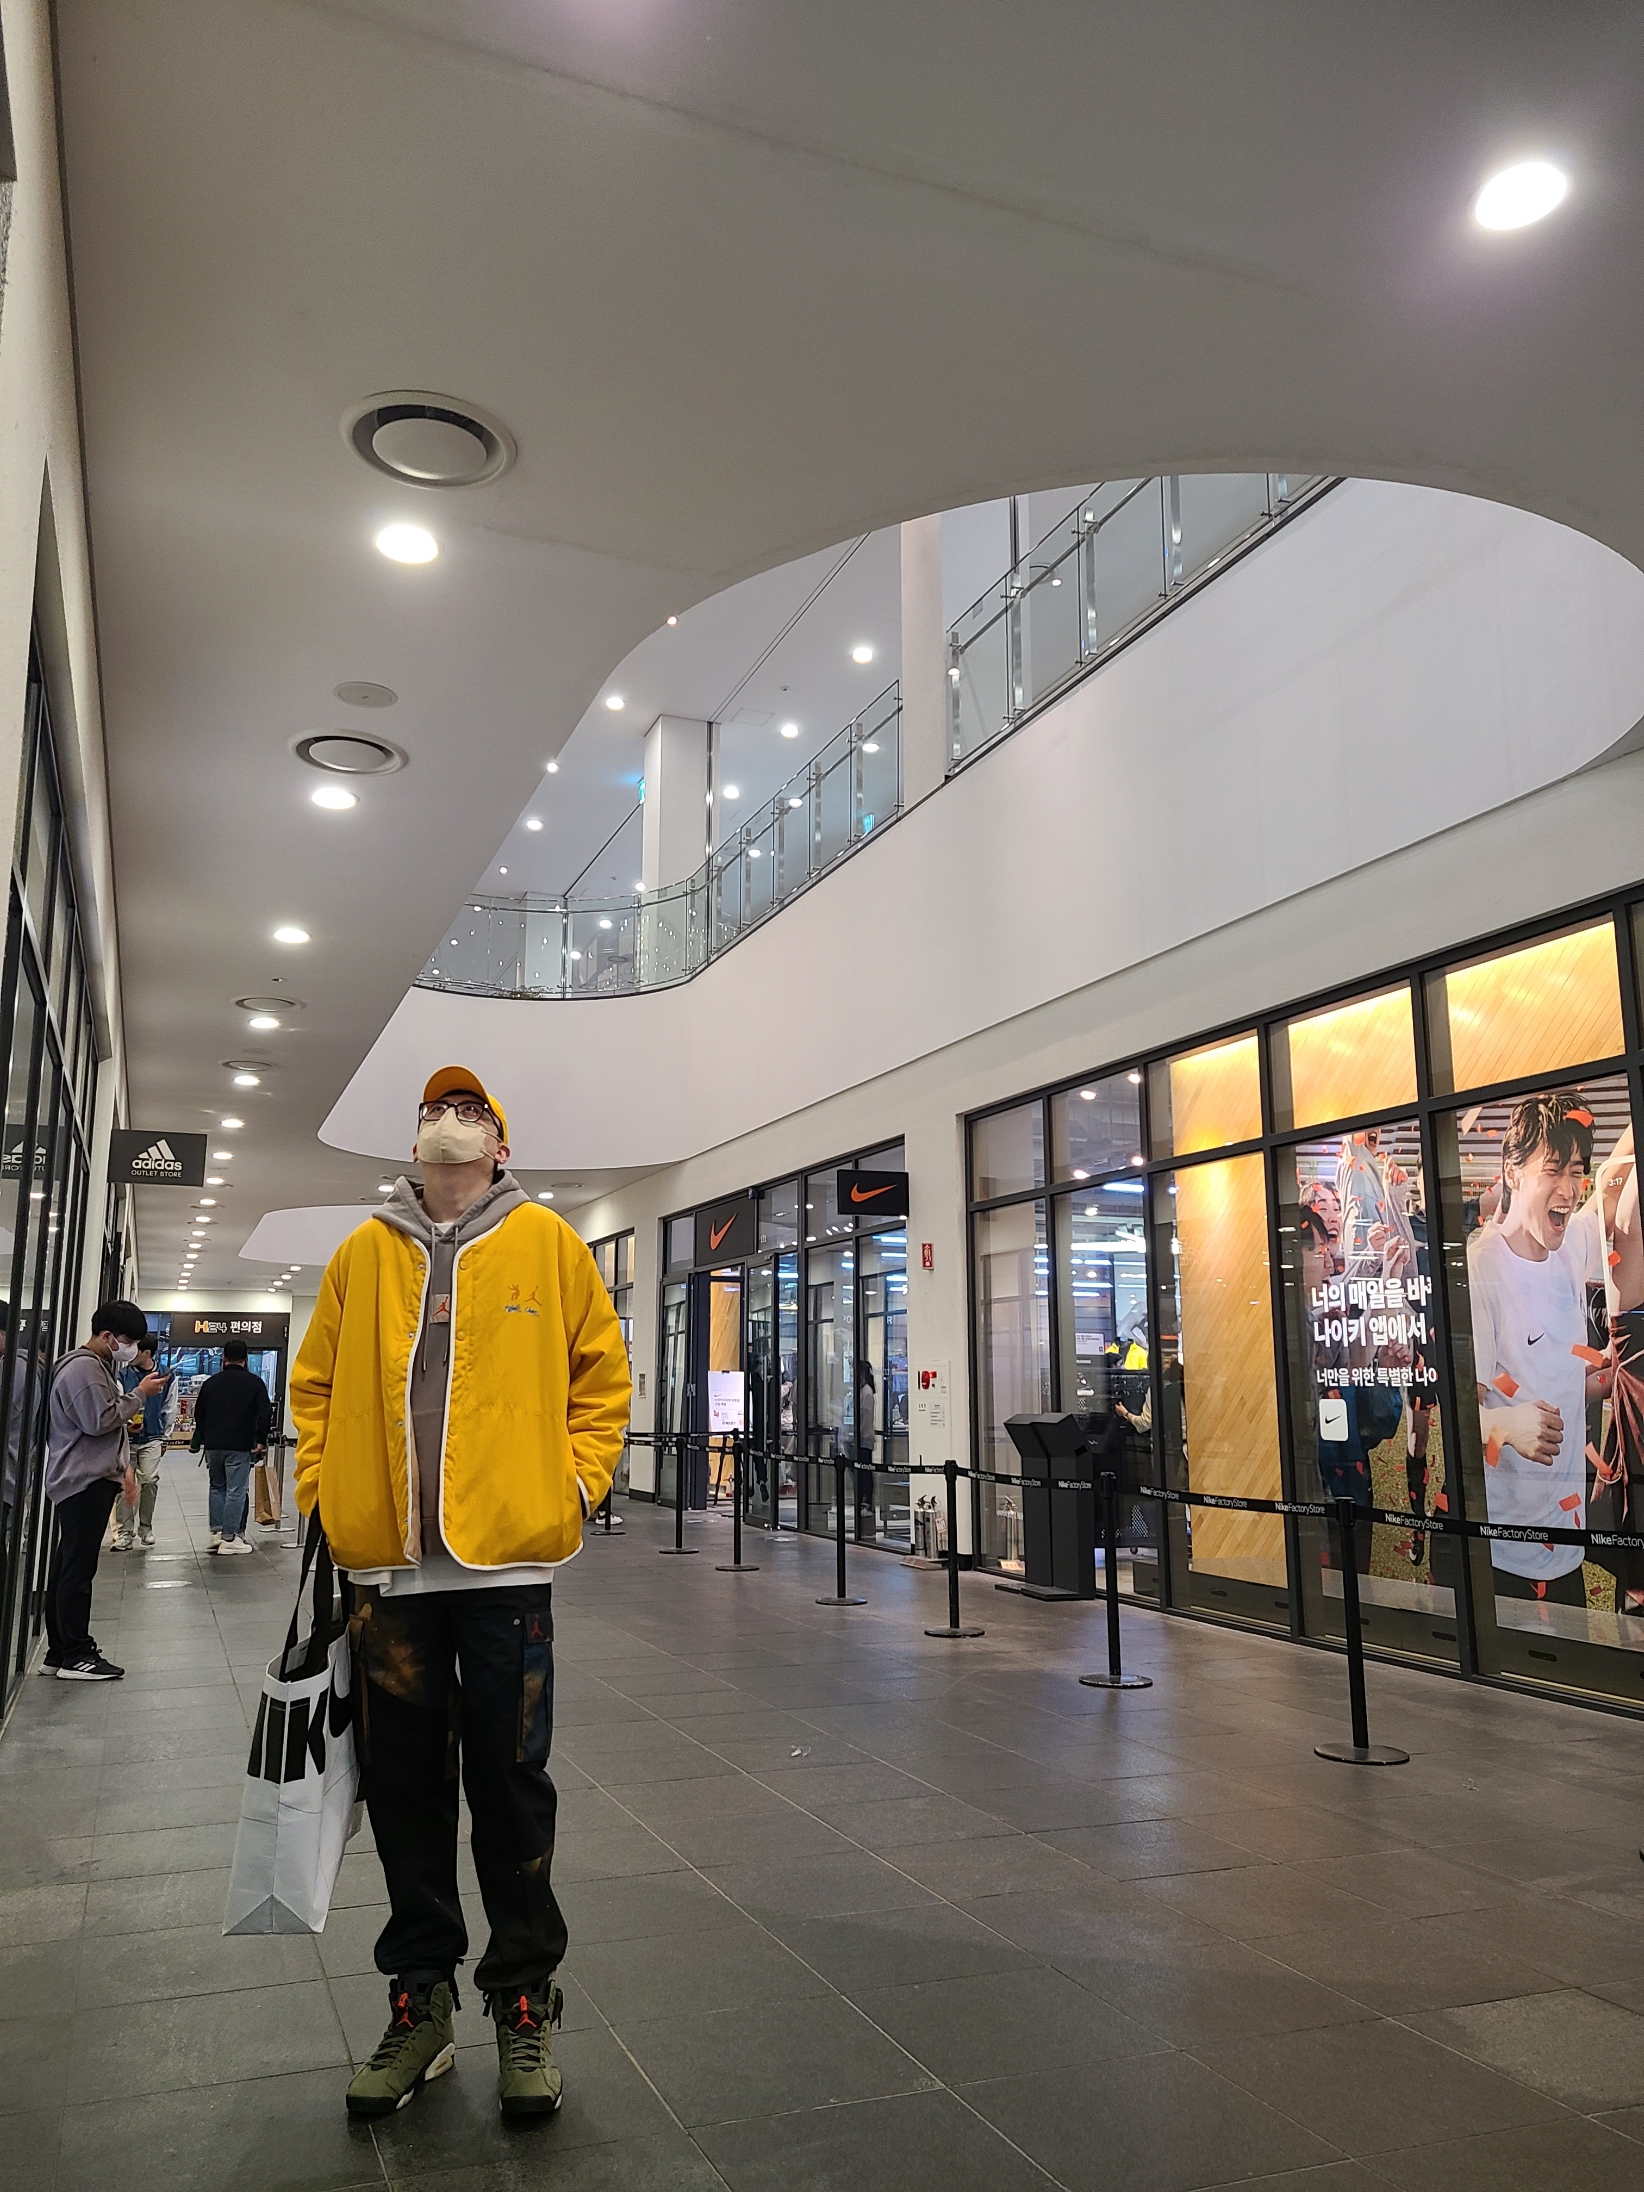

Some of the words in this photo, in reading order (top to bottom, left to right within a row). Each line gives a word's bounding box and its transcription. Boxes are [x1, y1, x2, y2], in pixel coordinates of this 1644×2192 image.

[132, 1158, 183, 1171] adidas
[1608, 1177, 1623, 1187] 3:17
[1311, 1282, 1346, 1313] 너의
[1348, 1278, 1405, 1310] 매일을
[194, 1320, 227, 1333] H24
[230, 1321, 262, 1333] 편의점
[1314, 1316, 1367, 1348] 나이키
[1369, 1313, 1427, 1346] 앱에서
[1316, 1368, 1350, 1387] 너만을
[1352, 1367, 1375, 1387] 위한
[1377, 1367, 1413, 1387] 특별한
